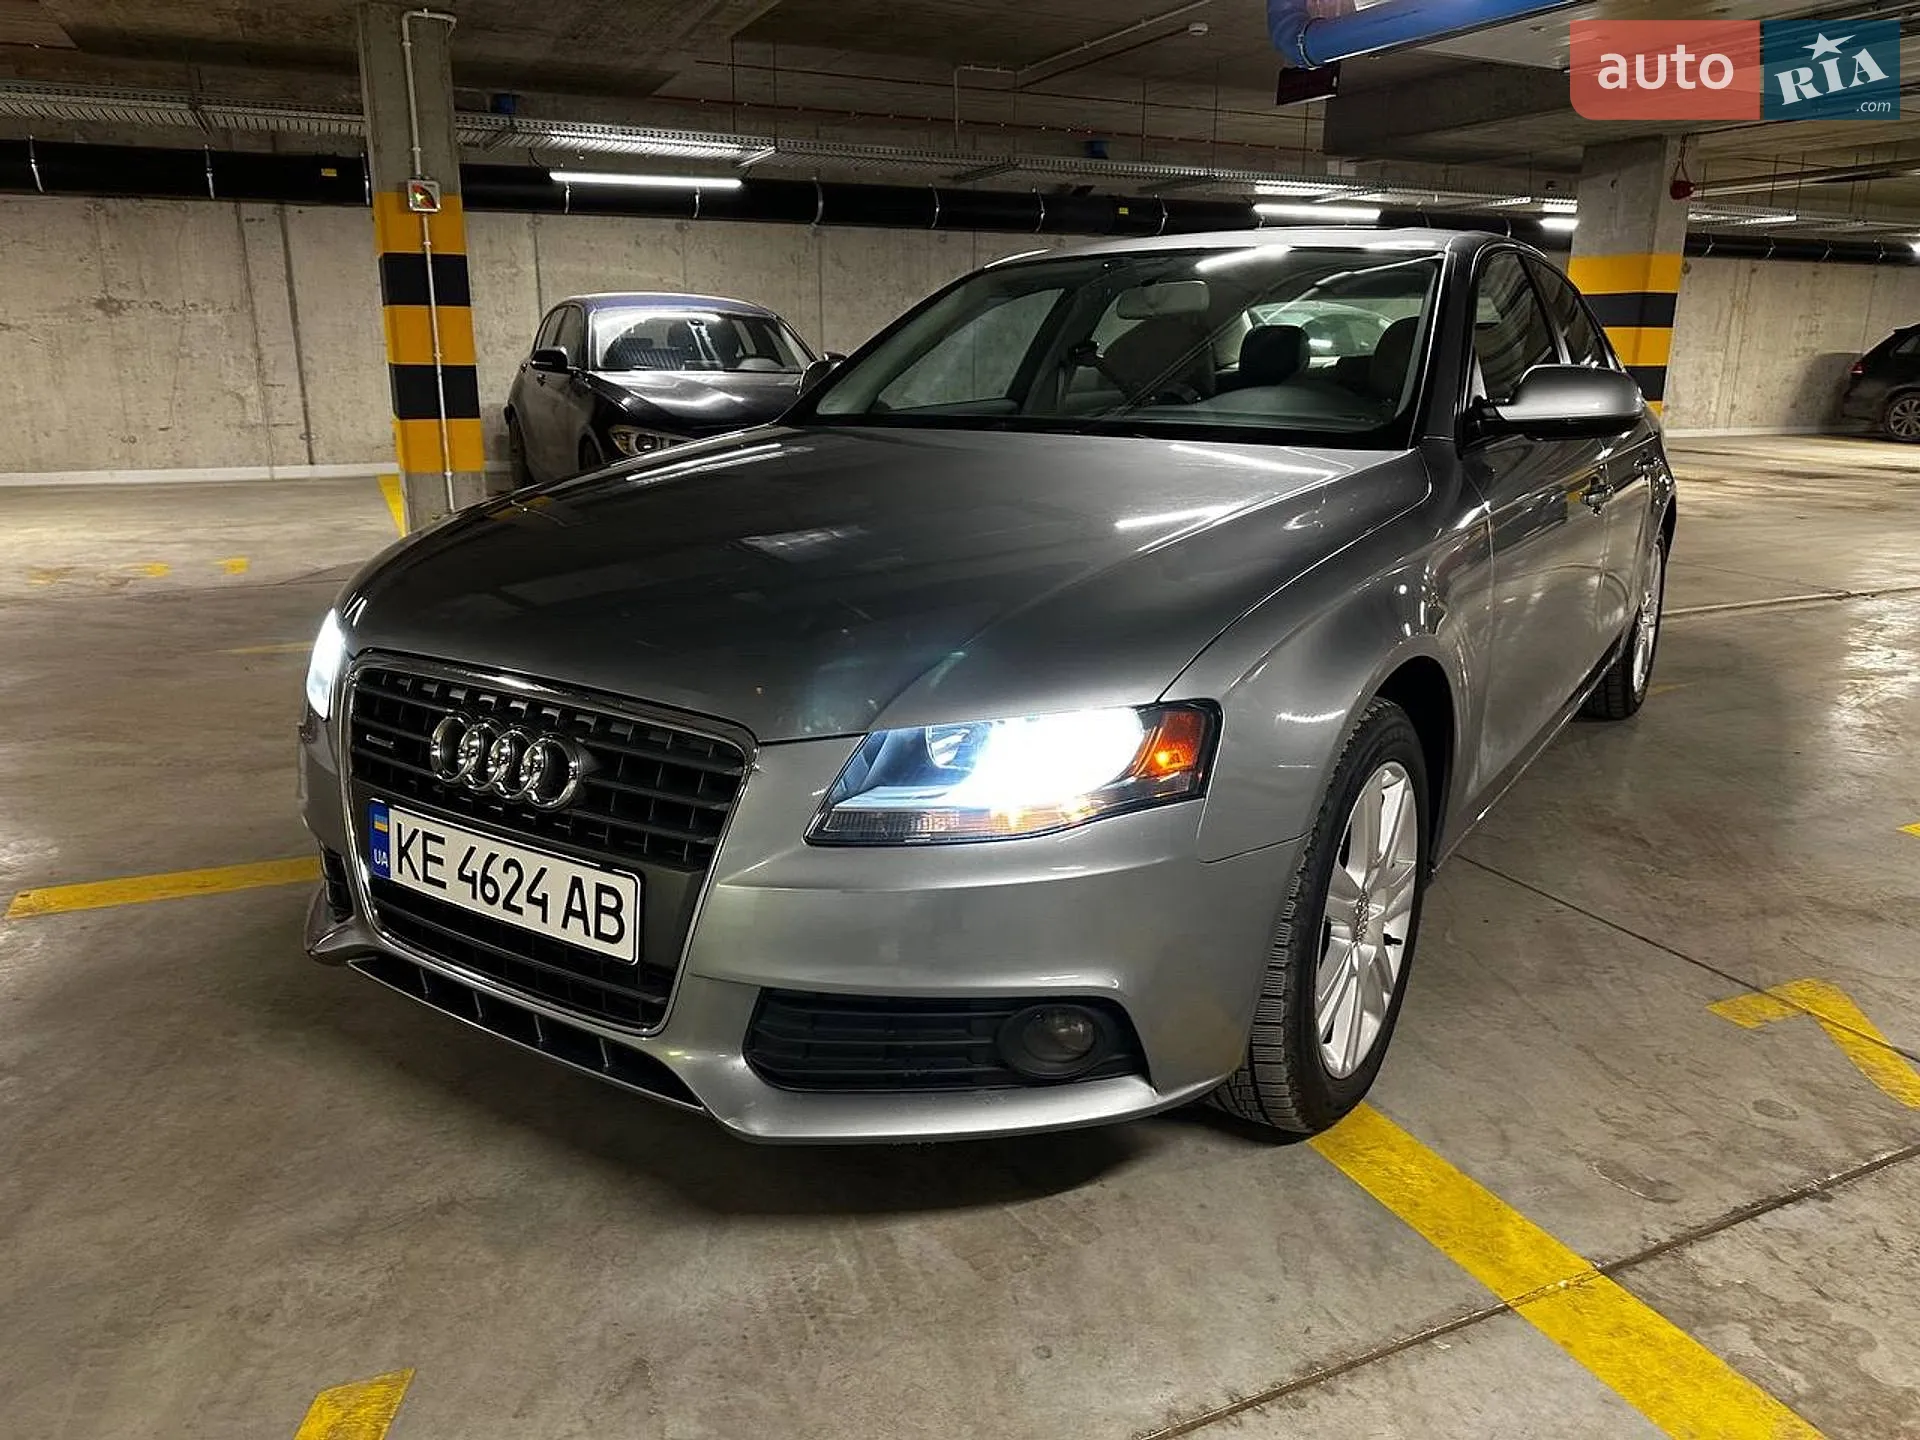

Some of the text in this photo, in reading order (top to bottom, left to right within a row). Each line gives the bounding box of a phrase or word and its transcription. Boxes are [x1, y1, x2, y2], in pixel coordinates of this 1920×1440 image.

[373, 849, 389, 868] UA
[397, 822, 625, 945] KE 4624 AB
